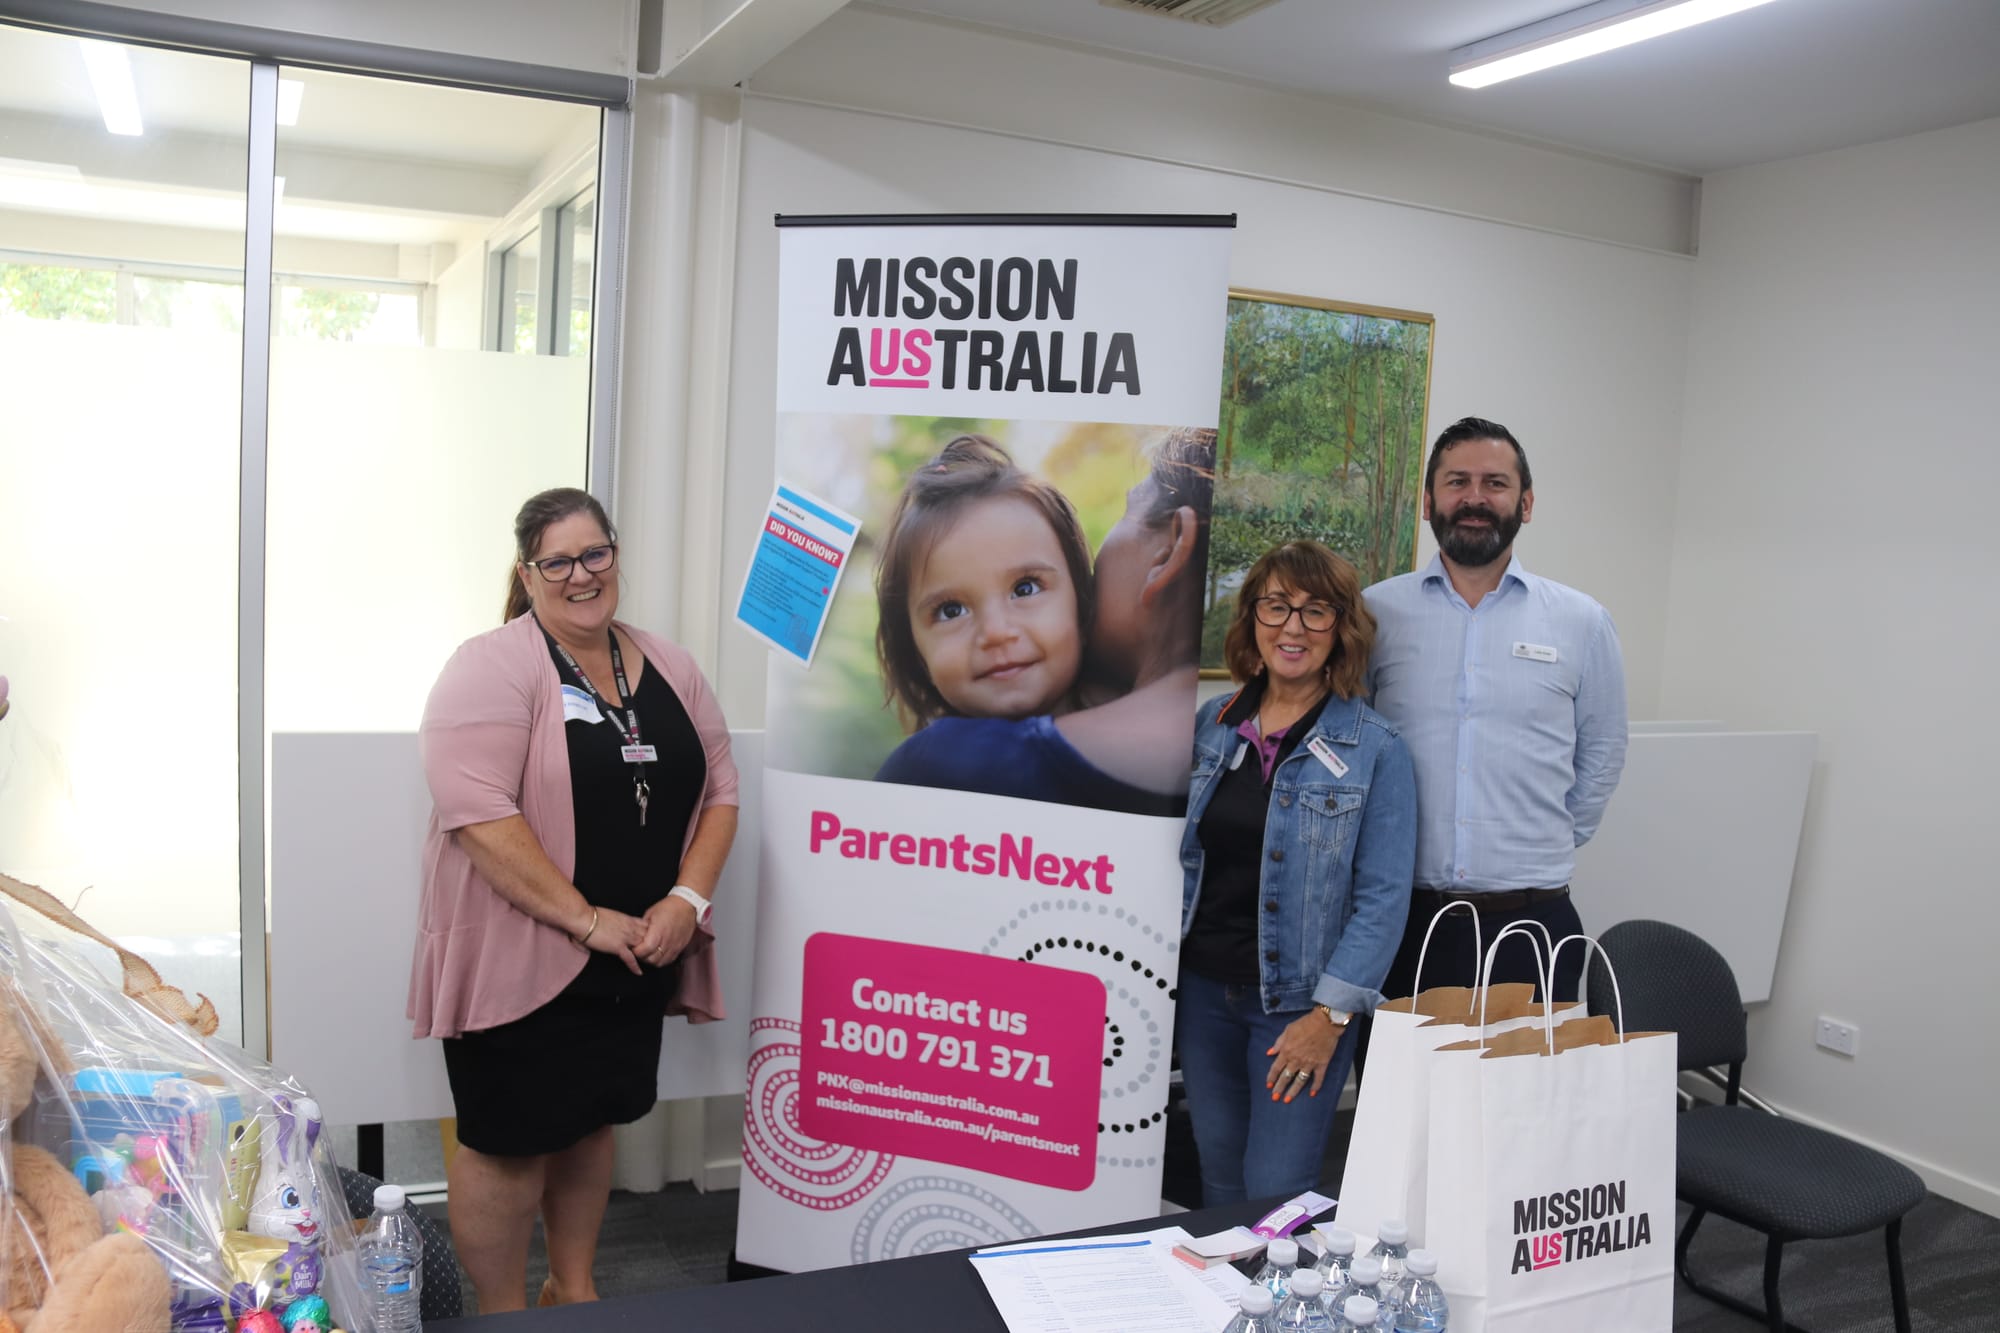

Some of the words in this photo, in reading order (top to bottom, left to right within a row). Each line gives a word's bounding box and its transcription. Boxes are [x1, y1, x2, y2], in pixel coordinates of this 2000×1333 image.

[834, 256, 1078, 321] MISSION
[827, 327, 1141, 395] AUSTRALIA
[770, 520, 786, 535] DID
[787, 528, 806, 546] YOU
[805, 539, 839, 563] KNOW?
[809, 810, 1115, 894] ParentsNext
[852, 978, 981, 1027] Contact
[988, 1008, 1028, 1035] us
[820, 1018, 908, 1059] 1800
[917, 1032, 980, 1072] 791
[989, 1045, 1053, 1088] 371
[816, 1095, 1080, 1156] missionaustralia.com.au/parentsnext
[817, 1071, 1039, 1125] PNX@missionaustralia.com.au
[1513, 1180, 1625, 1235] MISSION
[1511, 1212, 1651, 1275] AUSTRALIA
